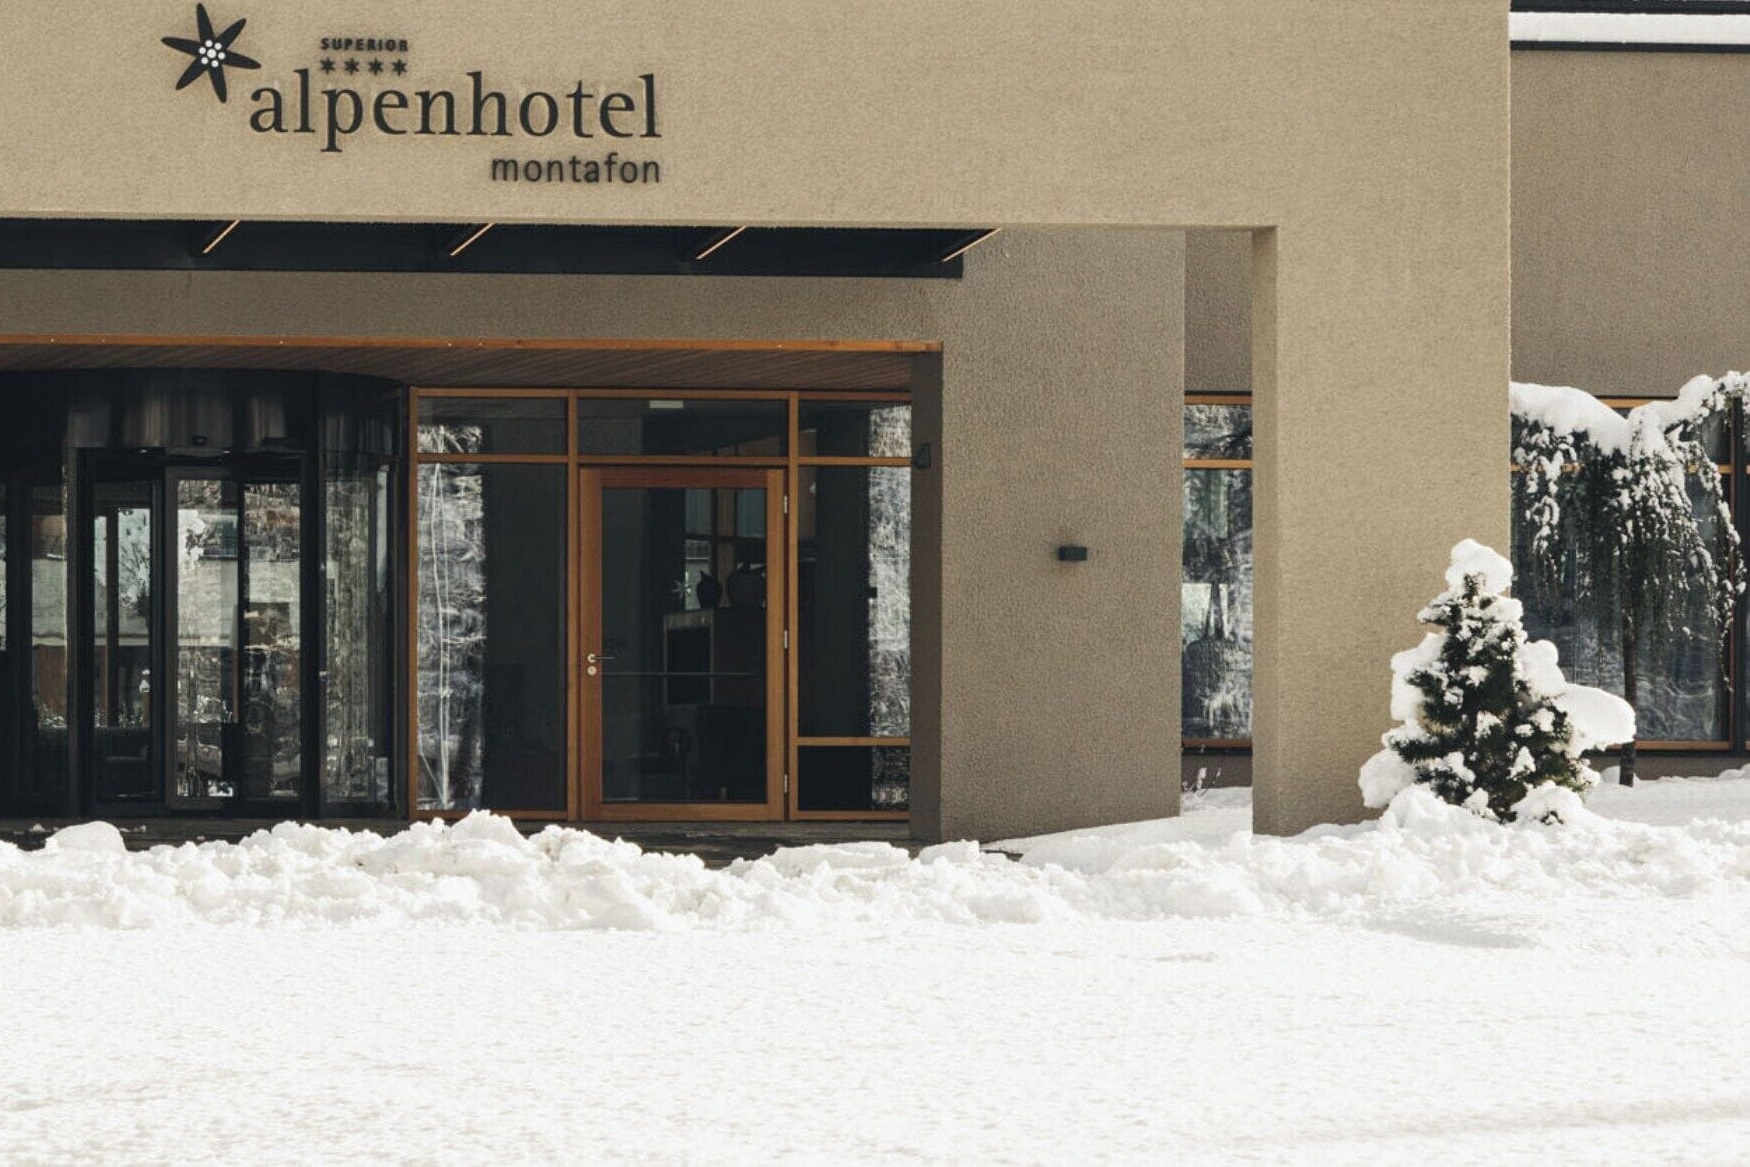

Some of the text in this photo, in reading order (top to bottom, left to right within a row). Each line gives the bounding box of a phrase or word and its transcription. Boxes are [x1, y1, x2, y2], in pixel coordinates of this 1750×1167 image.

[320, 37, 409, 52] SUPERIOR
[249, 68, 662, 153] alpenhotel
[491, 152, 661, 184] montafon
